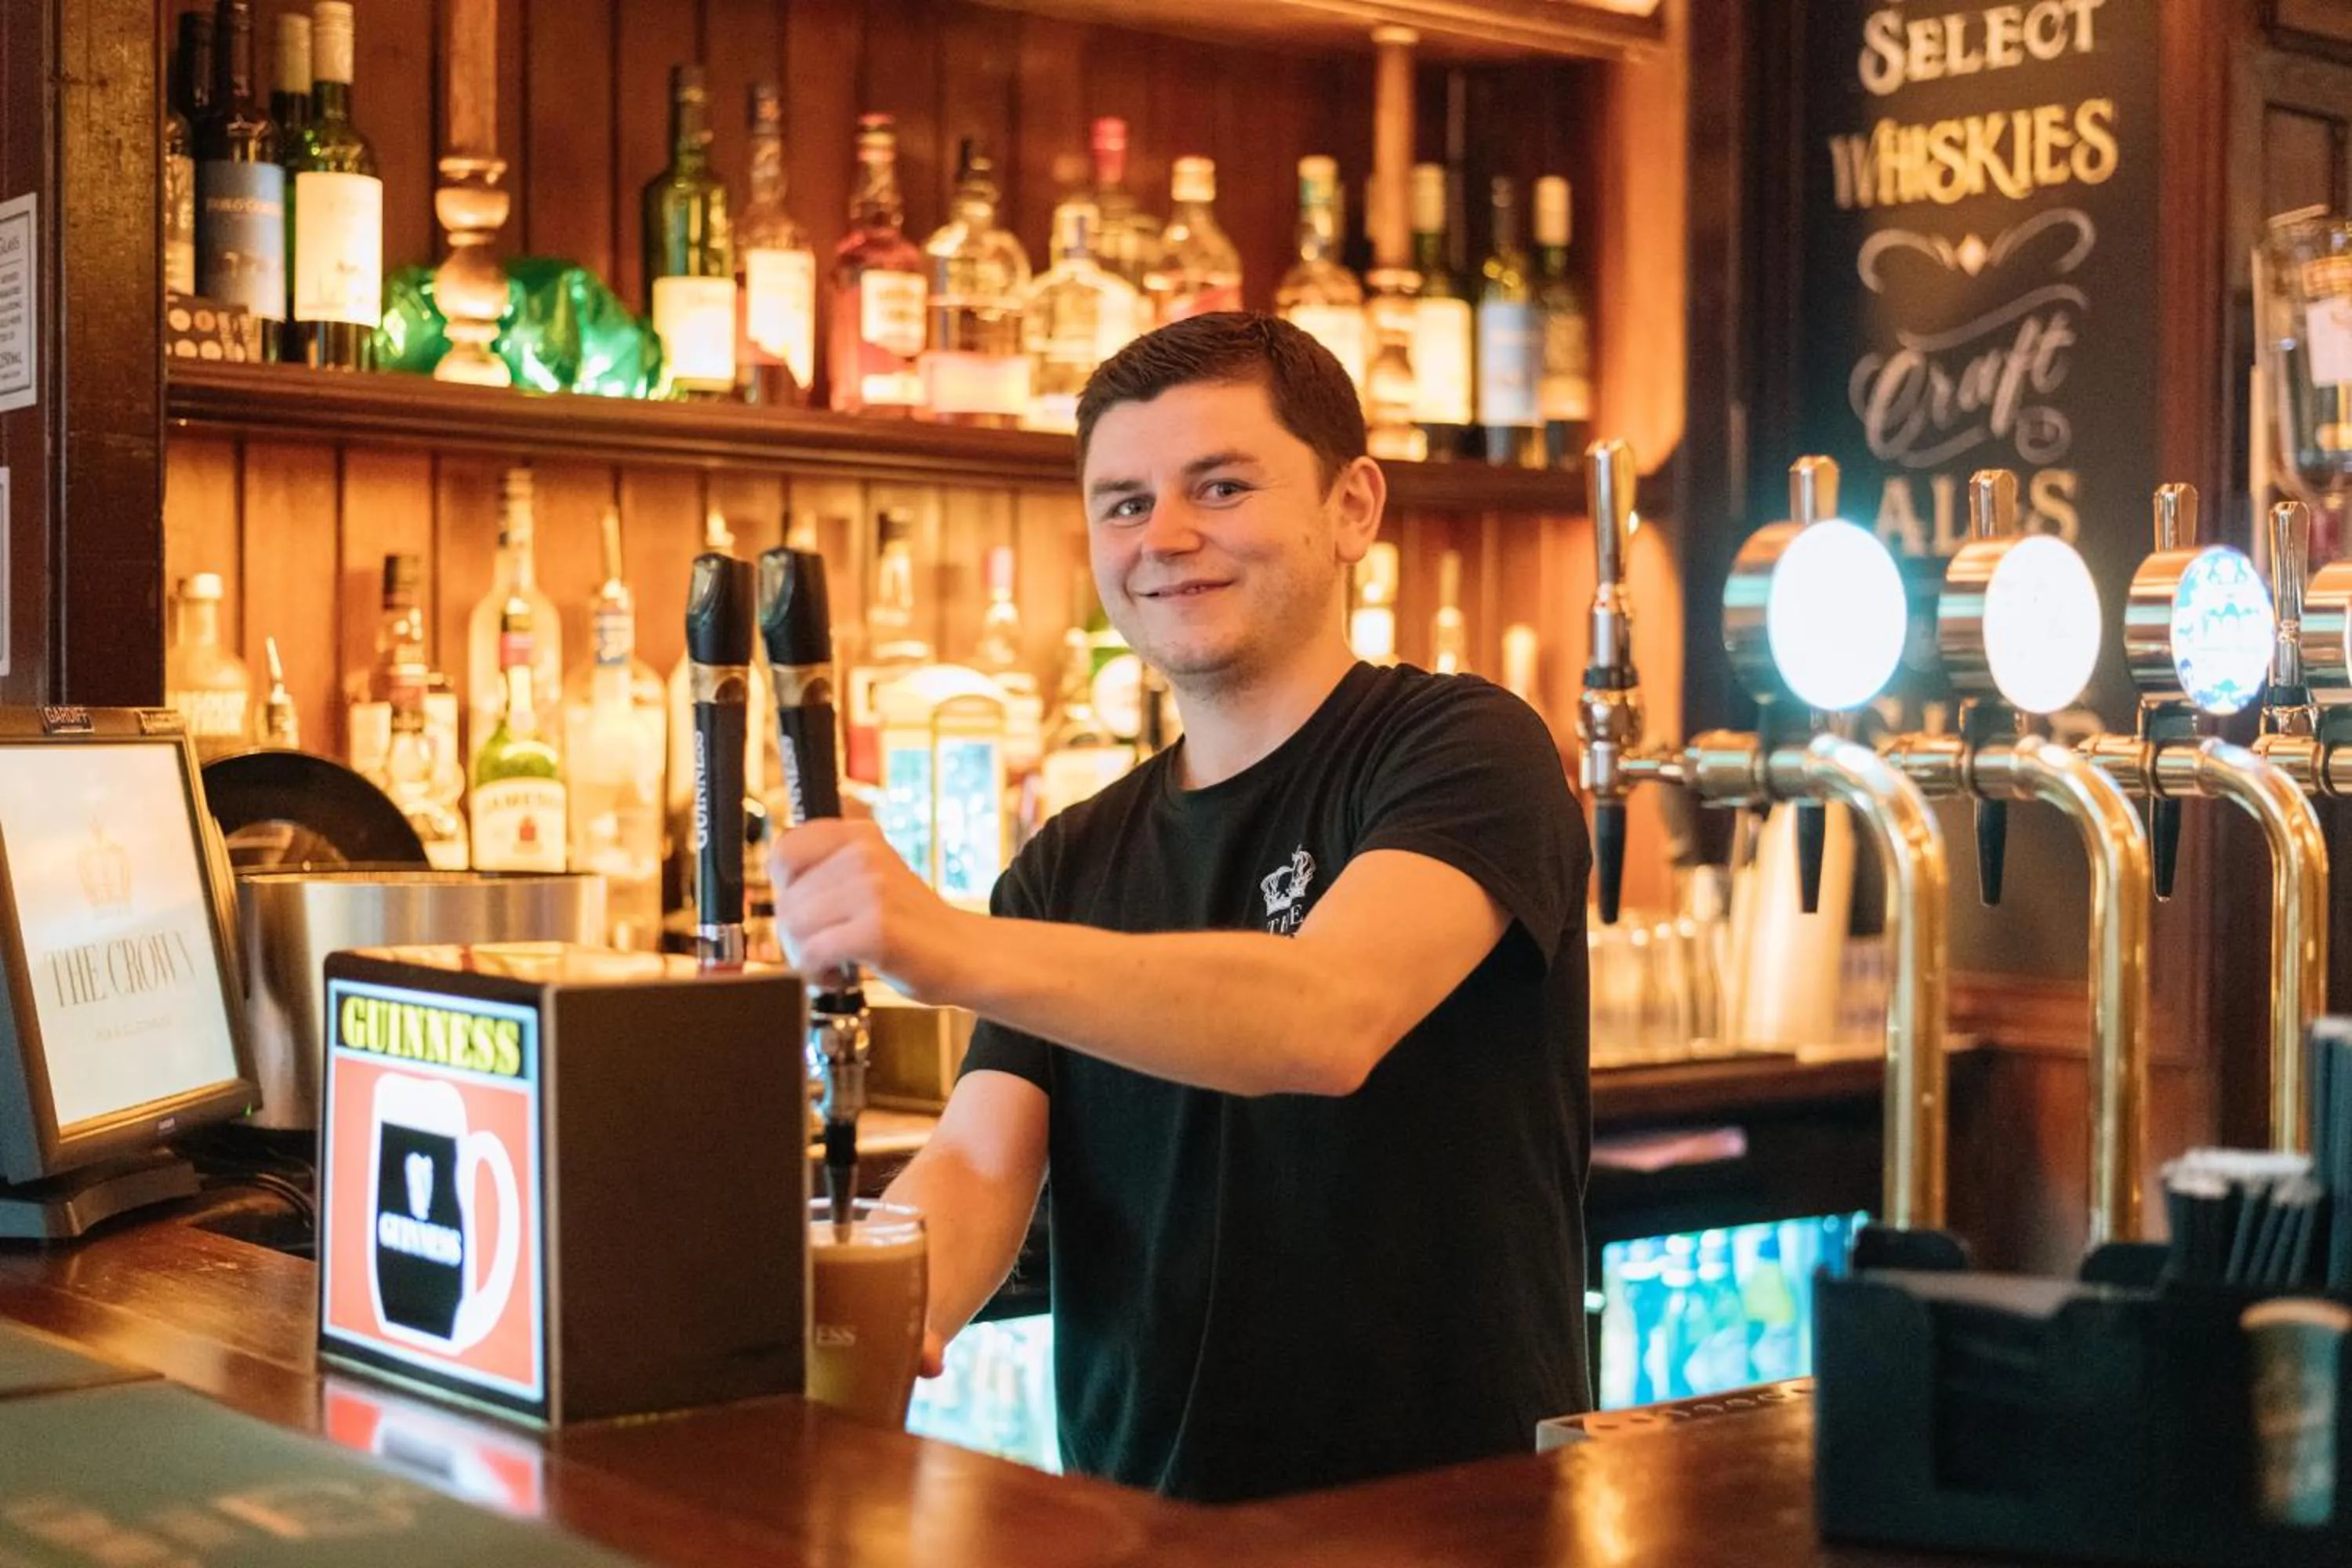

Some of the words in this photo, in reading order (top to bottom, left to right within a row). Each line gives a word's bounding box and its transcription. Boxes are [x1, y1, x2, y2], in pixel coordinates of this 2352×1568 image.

[1858, 0, 2107, 96] SELECT
[1830, 97, 2118, 209] WHISKIES
[1848, 310, 2078, 469] Craft
[1872, 469, 2080, 557] ALS
[1266, 904, 1304, 935] THE
[45, 943, 107, 1007] THE
[341, 996, 521, 1076] GUINNESS
